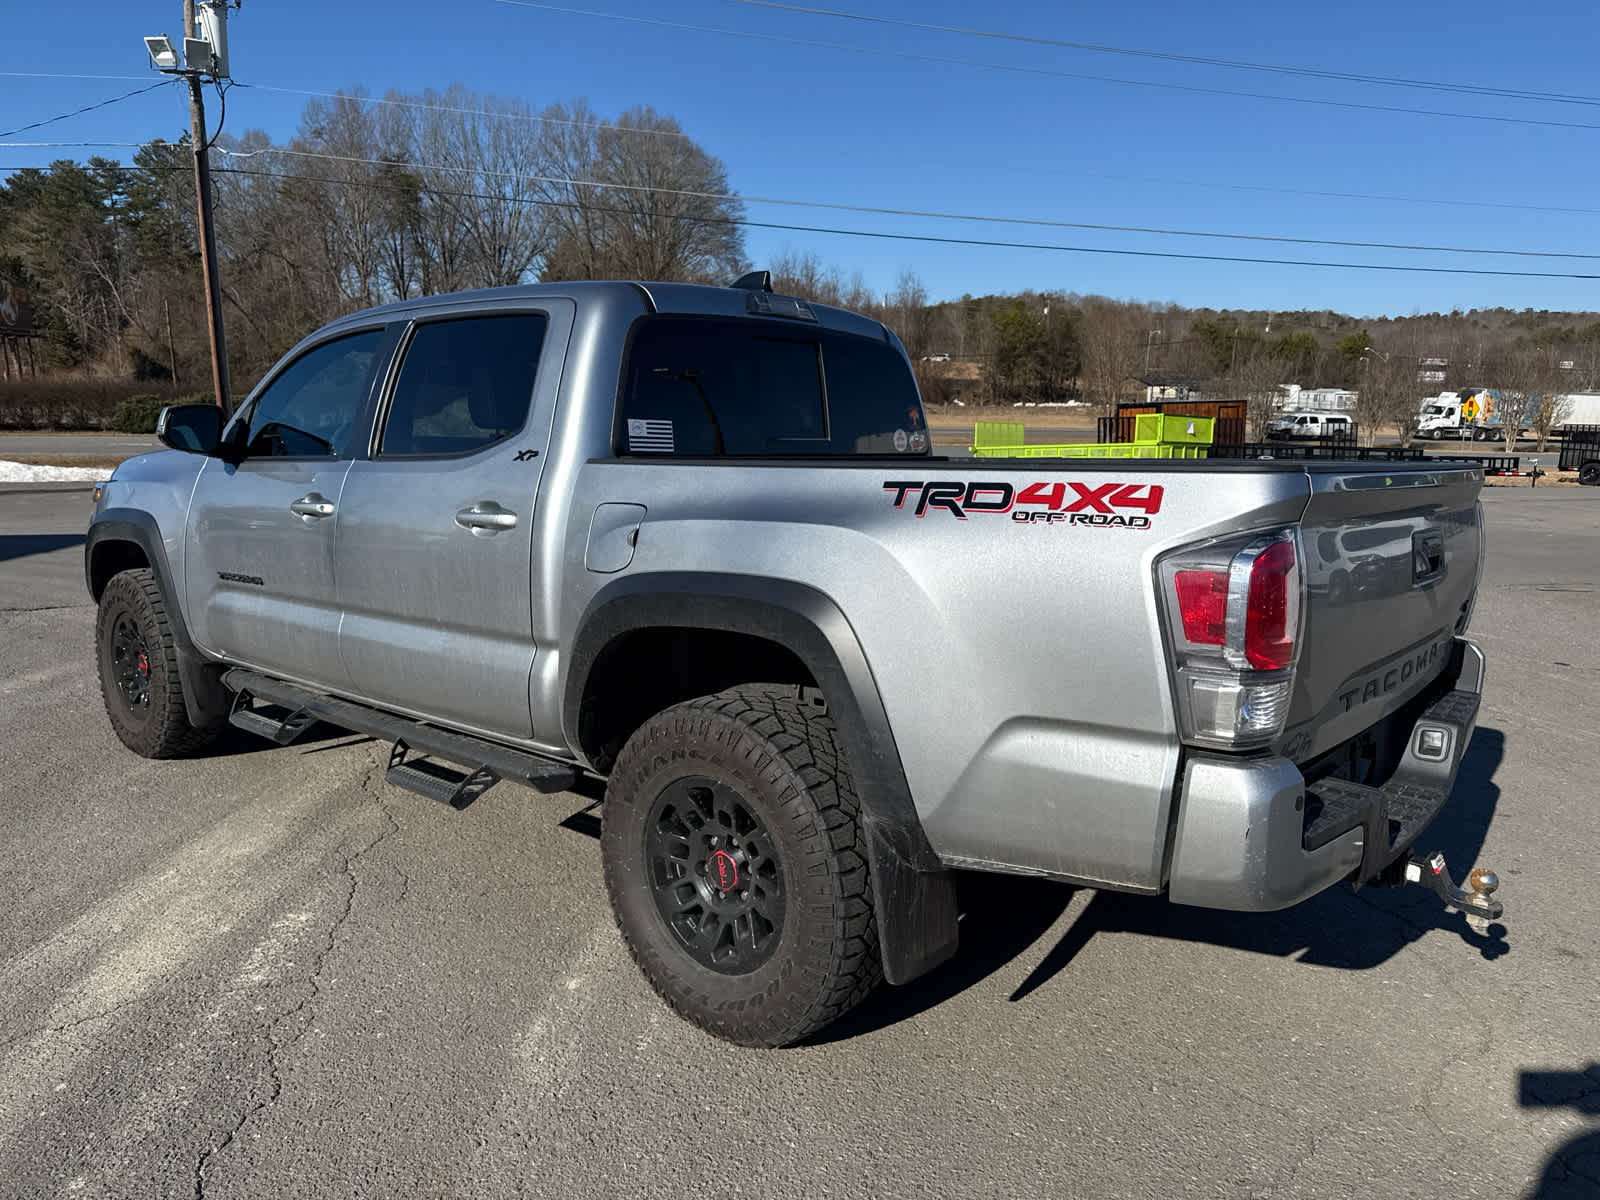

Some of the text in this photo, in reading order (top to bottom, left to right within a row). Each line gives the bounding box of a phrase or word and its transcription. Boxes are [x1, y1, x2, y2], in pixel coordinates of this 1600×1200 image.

[882, 480, 1164, 521] TRD 4X4
[1011, 510, 1152, 530] OFF ROAD
[1338, 642, 1439, 713] TACOMA
